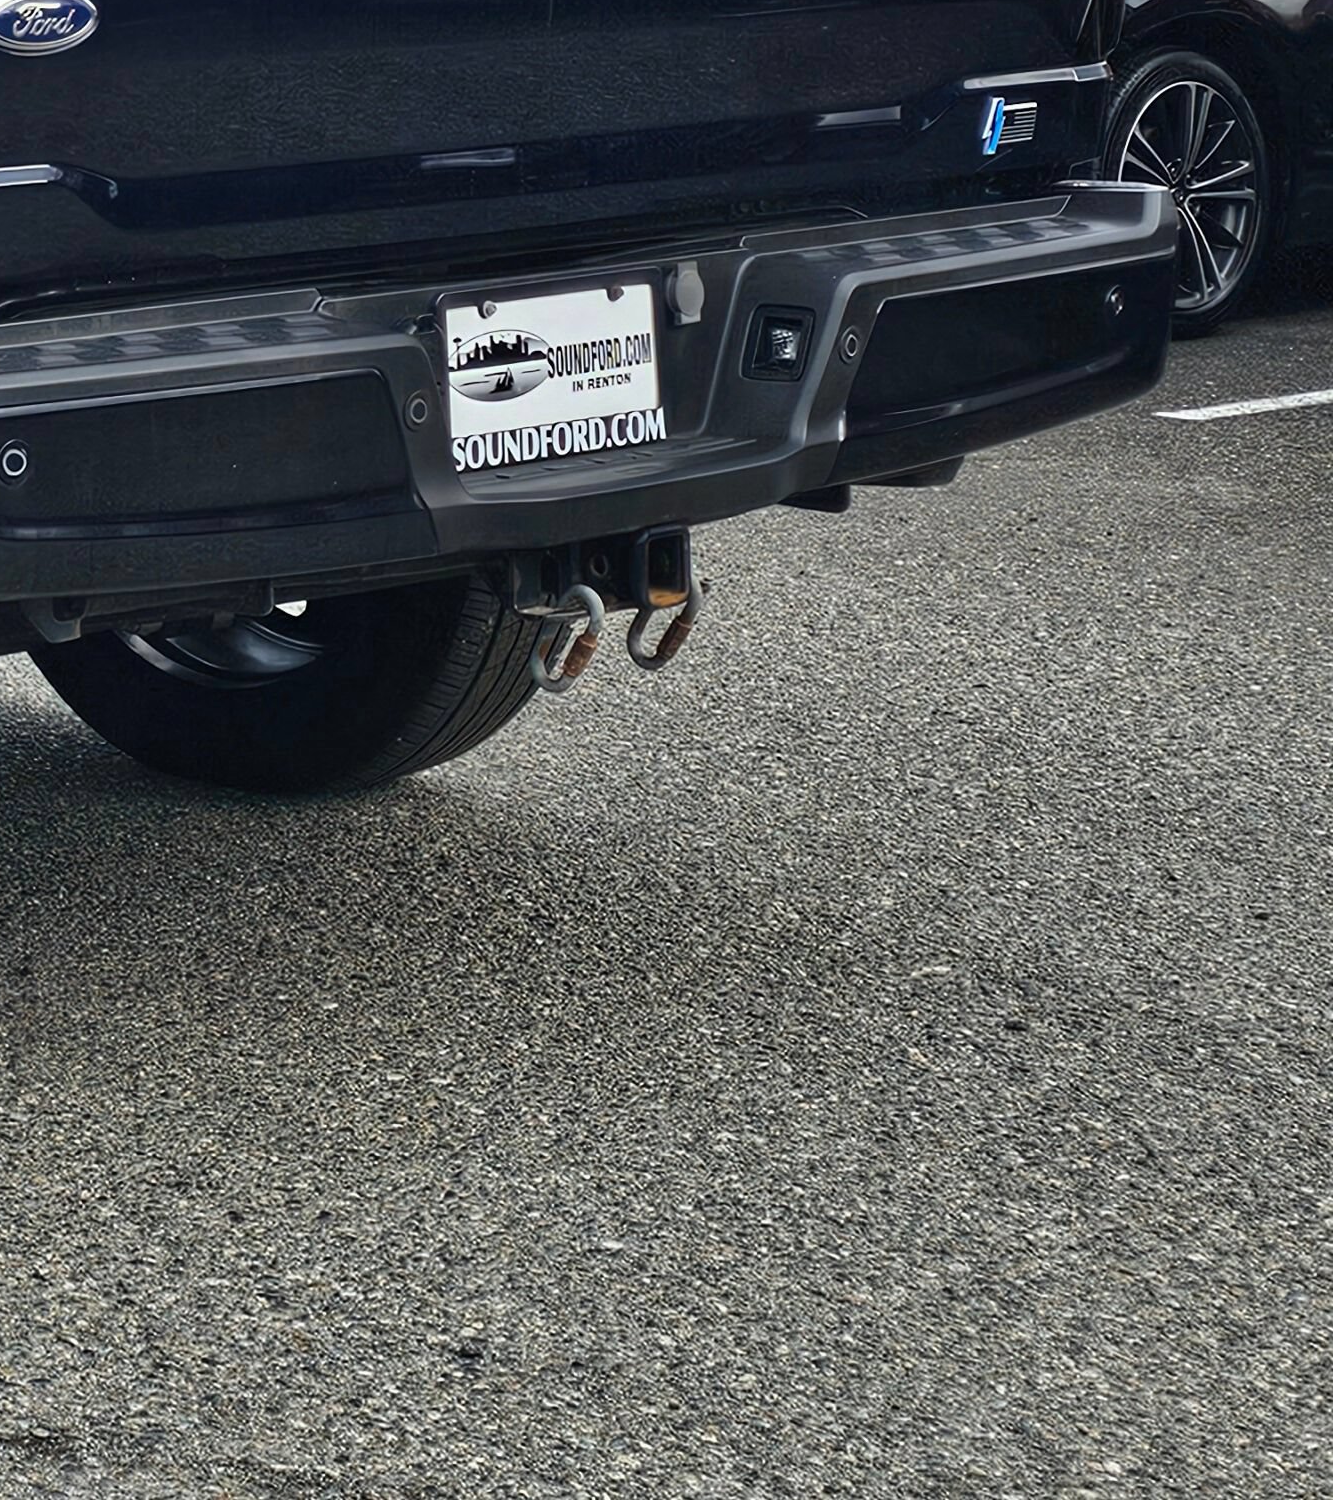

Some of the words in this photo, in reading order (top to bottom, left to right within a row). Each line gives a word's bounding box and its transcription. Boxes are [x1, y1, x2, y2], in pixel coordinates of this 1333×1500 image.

[12, 2, 76, 38] Ford
[546, 333, 652, 379] SOUNDFORD.COM
[572, 380, 584, 393] IN
[587, 372, 633, 390] RENTON
[451, 406, 668, 472] SOUNDFORD.COM
